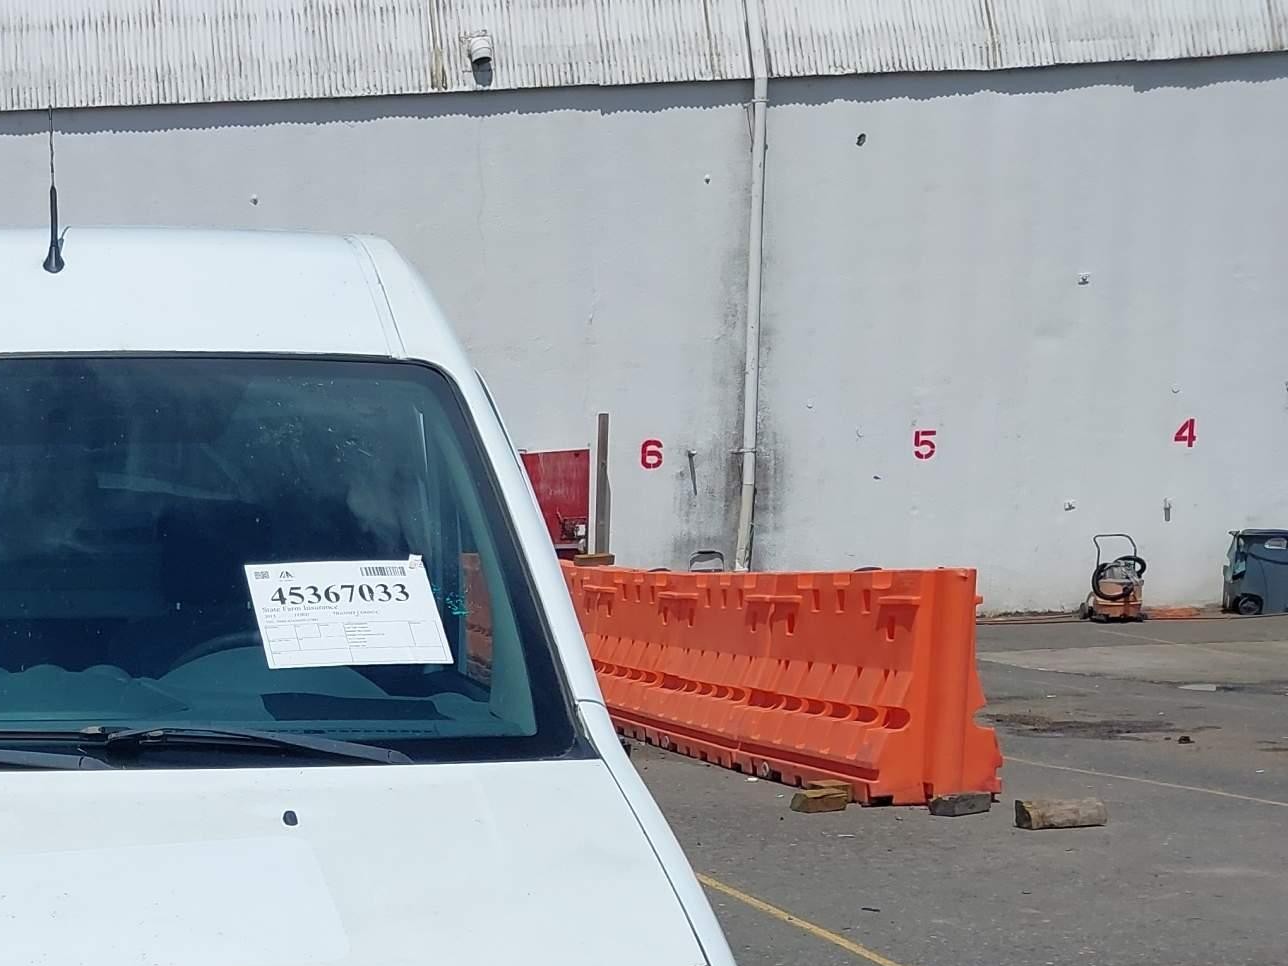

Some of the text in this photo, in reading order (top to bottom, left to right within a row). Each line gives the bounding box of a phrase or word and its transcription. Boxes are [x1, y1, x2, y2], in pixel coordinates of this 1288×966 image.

[913, 430, 935, 459] 5
[1174, 419, 1196, 447] 4
[640, 439, 663, 469] 6
[270, 583, 410, 606] 45367033
[303, 604, 339, 612] Insurance
